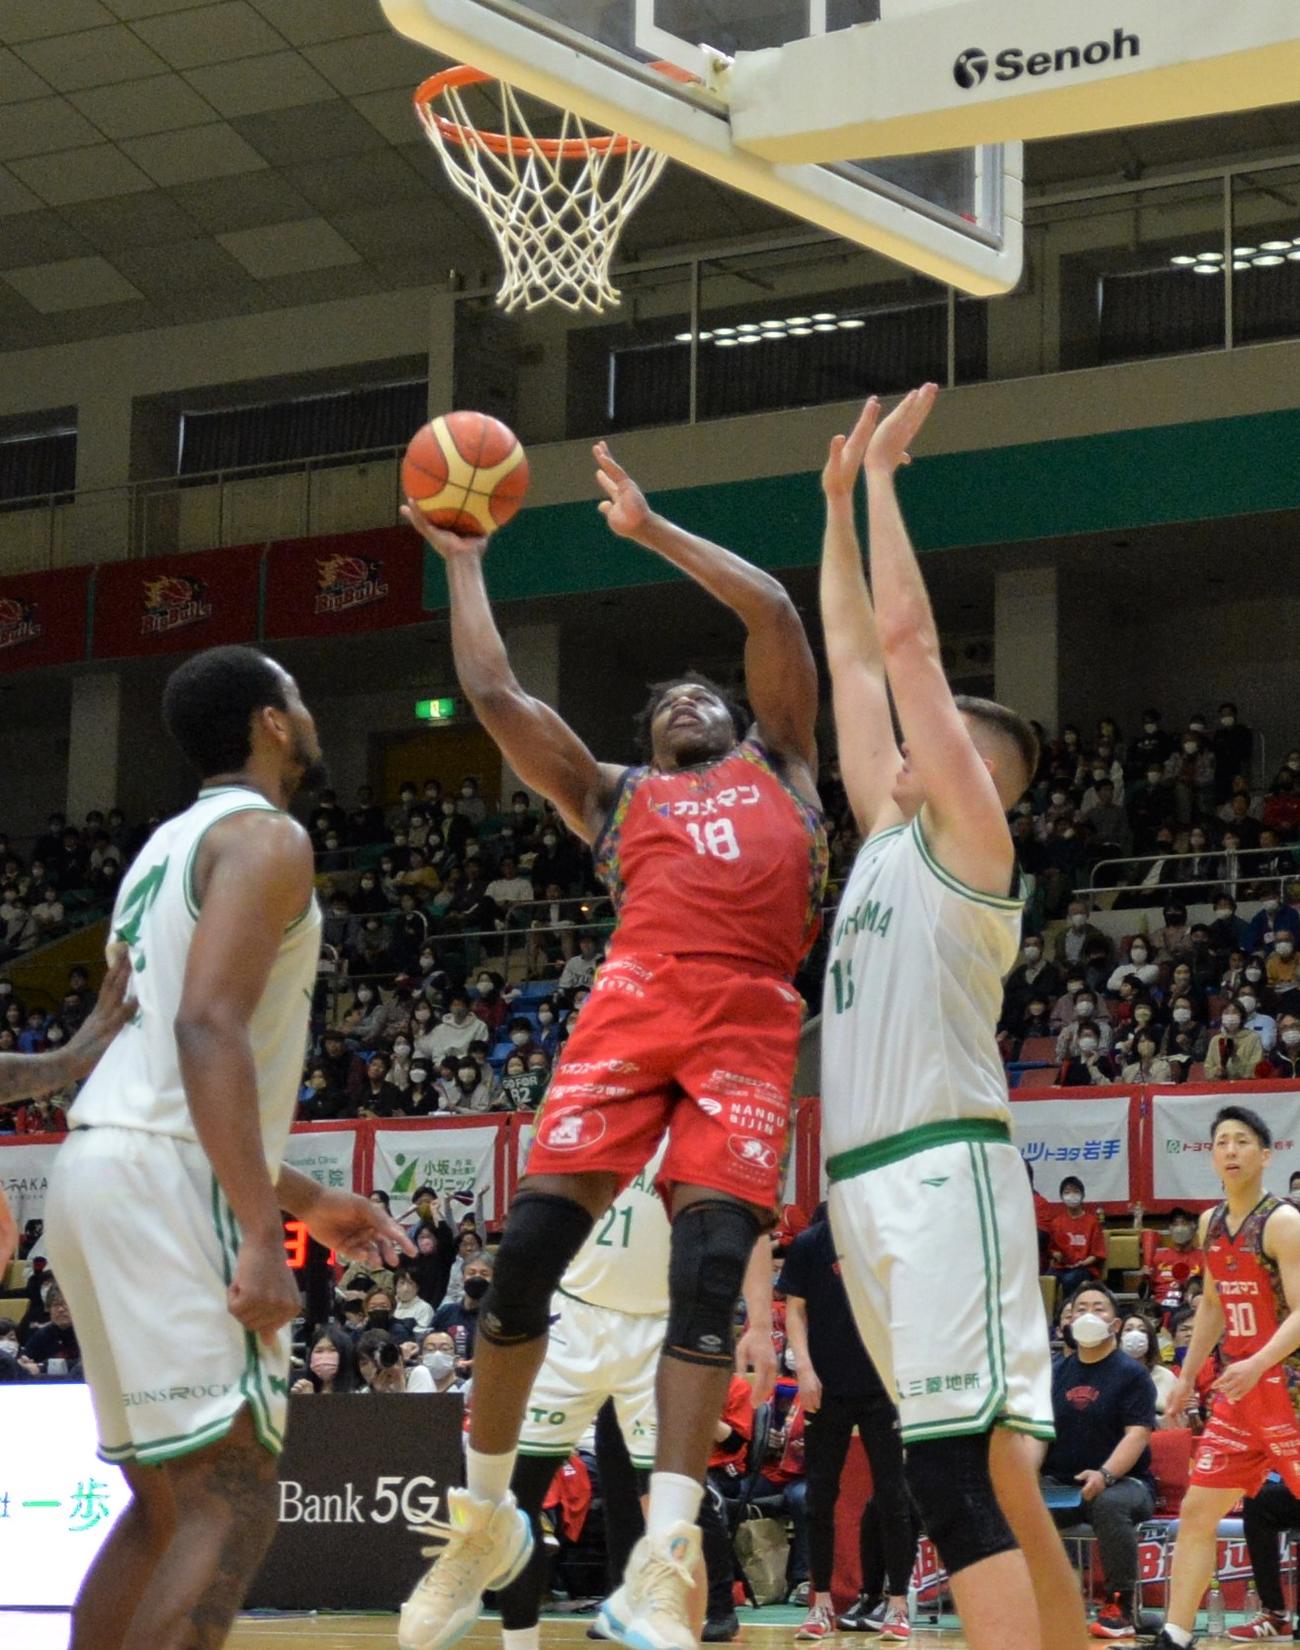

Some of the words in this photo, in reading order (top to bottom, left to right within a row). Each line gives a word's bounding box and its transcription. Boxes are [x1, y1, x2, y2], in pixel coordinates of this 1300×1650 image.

[995, 28, 1140, 81] Senoh
[686, 818, 740, 860] 18
[515, 1076, 538, 1088] FOR
[729, 1113, 775, 1136] BIJIN
[731, 1103, 785, 1127] NANBU
[424, 1159, 450, 1176] 小坂
[424, 1177, 477, 1192] クリニック
[596, 1205, 632, 1248] 21
[1226, 1302, 1257, 1336] 30
[909, 1372, 980, 1397] 三菱地所
[278, 1481, 365, 1523] Bank
[370, 1476, 439, 1524] 5G
